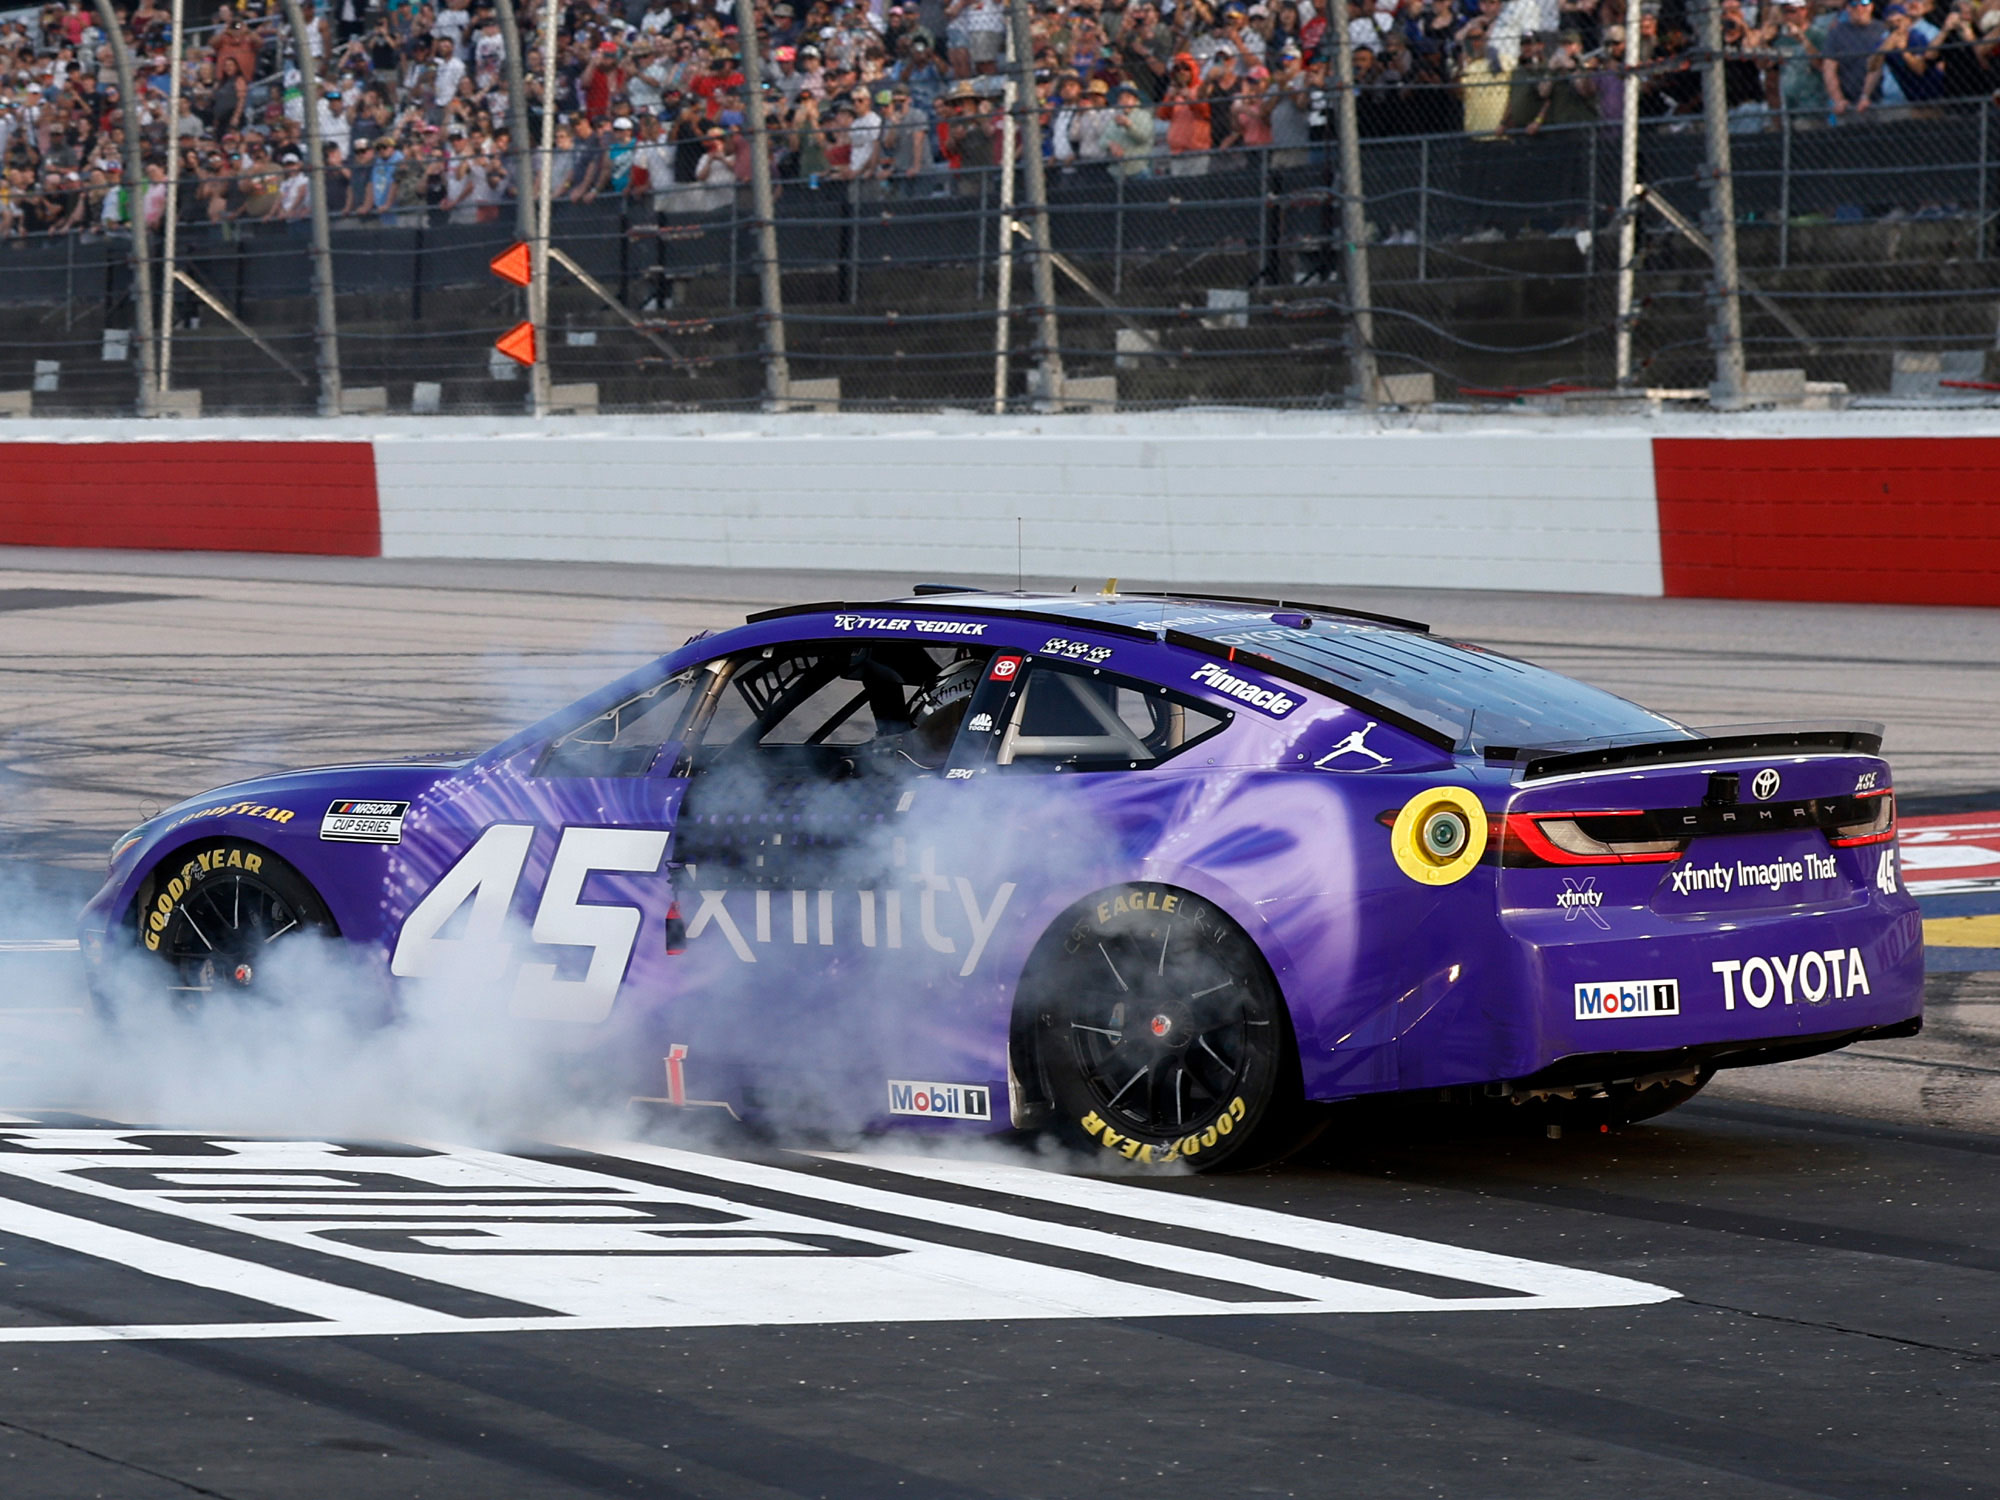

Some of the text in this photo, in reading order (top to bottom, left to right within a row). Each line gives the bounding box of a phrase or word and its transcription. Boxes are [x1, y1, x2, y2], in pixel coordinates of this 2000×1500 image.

[857, 617, 912, 631] TYLER
[913, 620, 989, 635] REDDICK
[1206, 629, 1322, 646] OYOTA
[1190, 662, 1298, 715] Pinnacle
[1855, 772, 1878, 790] XSE
[166, 801, 295, 832] GOODYEAR
[352, 803, 397, 816] NASCAR
[332, 819, 391, 833] CUP SERIES
[1672, 853, 1837, 896] xfinity Imagine That
[1876, 849, 1898, 895] 45
[145, 848, 263, 951] GOODYEAR
[1097, 892, 1178, 924] EAGLE
[1556, 888, 1603, 908] xfinity
[390, 822, 671, 1023] 45
[1712, 947, 1870, 1010] TOYOTA
[1579, 985, 1671, 1015] Mobil 1
[891, 1084, 982, 1114] Mobil 1
